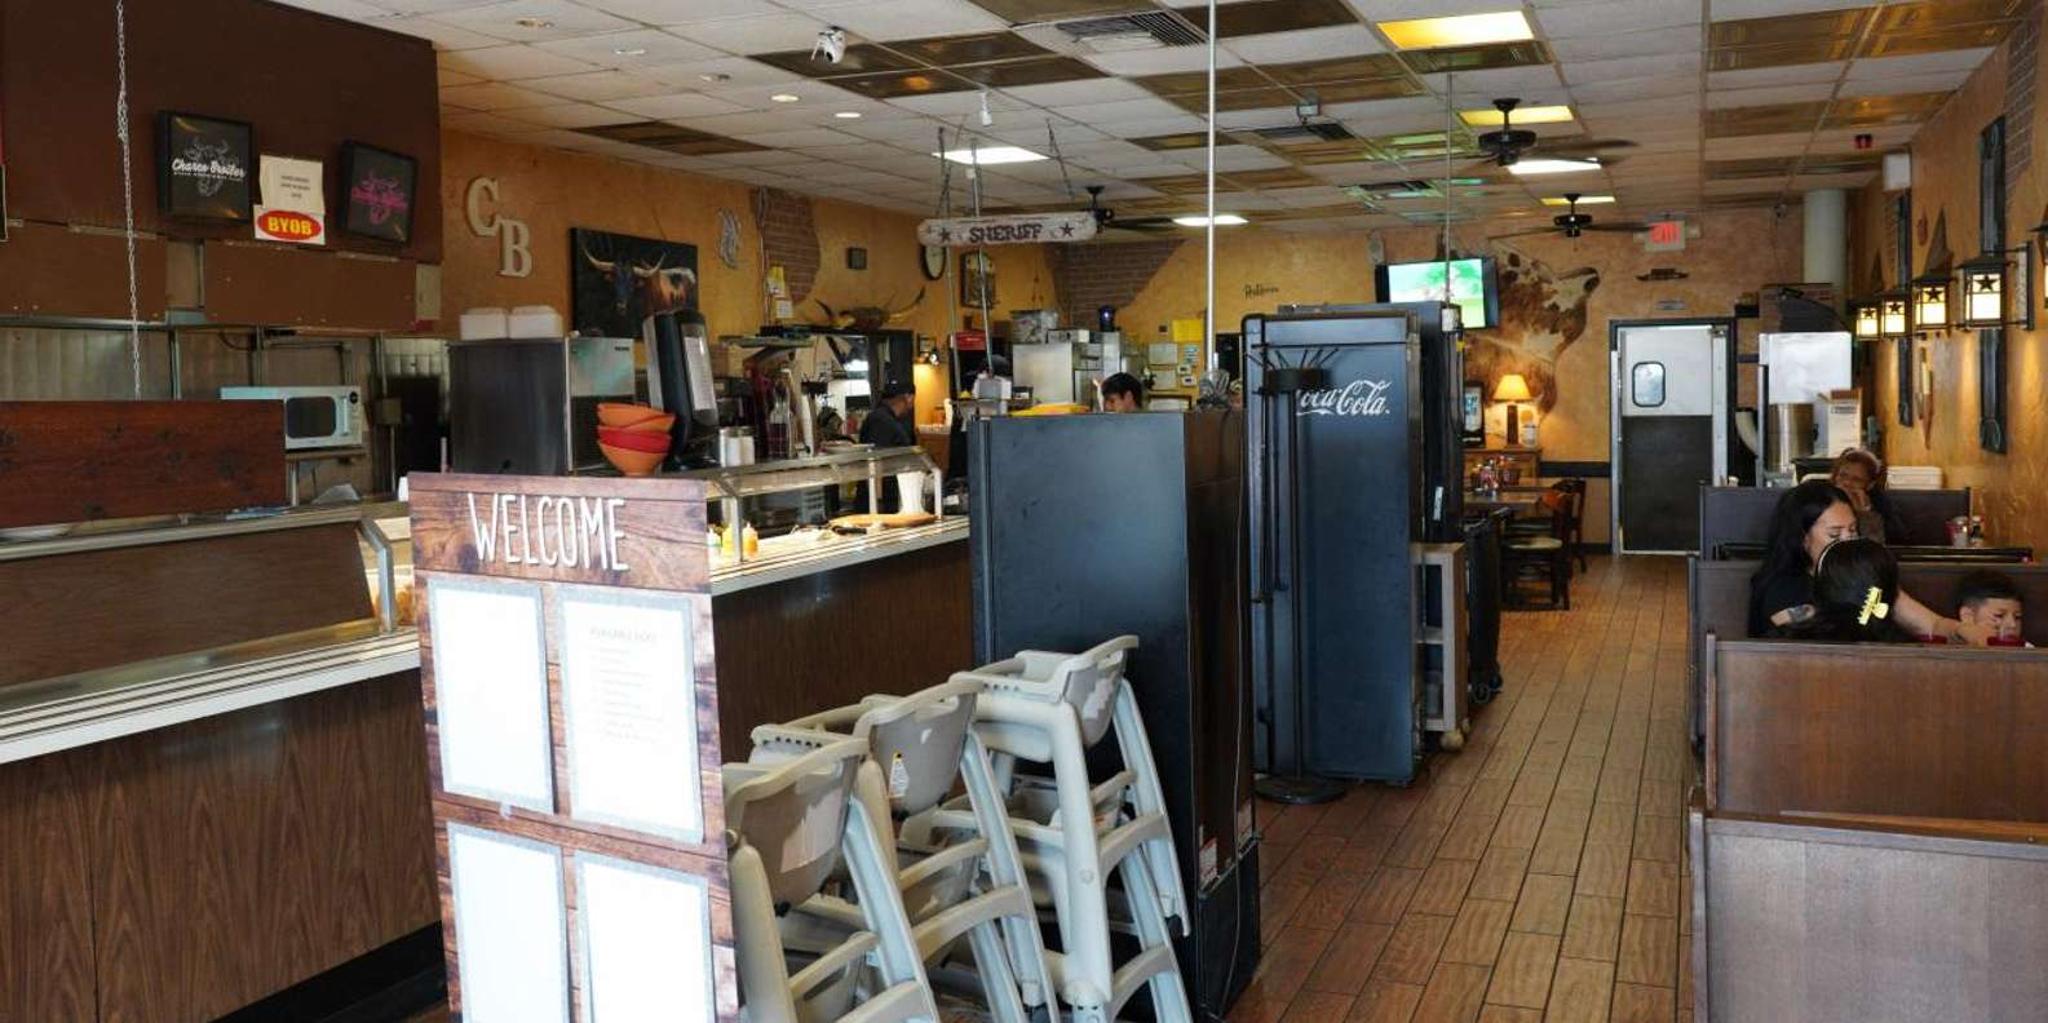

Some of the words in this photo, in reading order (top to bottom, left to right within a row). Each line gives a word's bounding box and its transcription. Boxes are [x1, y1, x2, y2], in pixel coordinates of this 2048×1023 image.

[268, 216, 313, 236] BYOB
[968, 223, 1043, 243] SHERIFF
[467, 493, 631, 571] WELCOME
